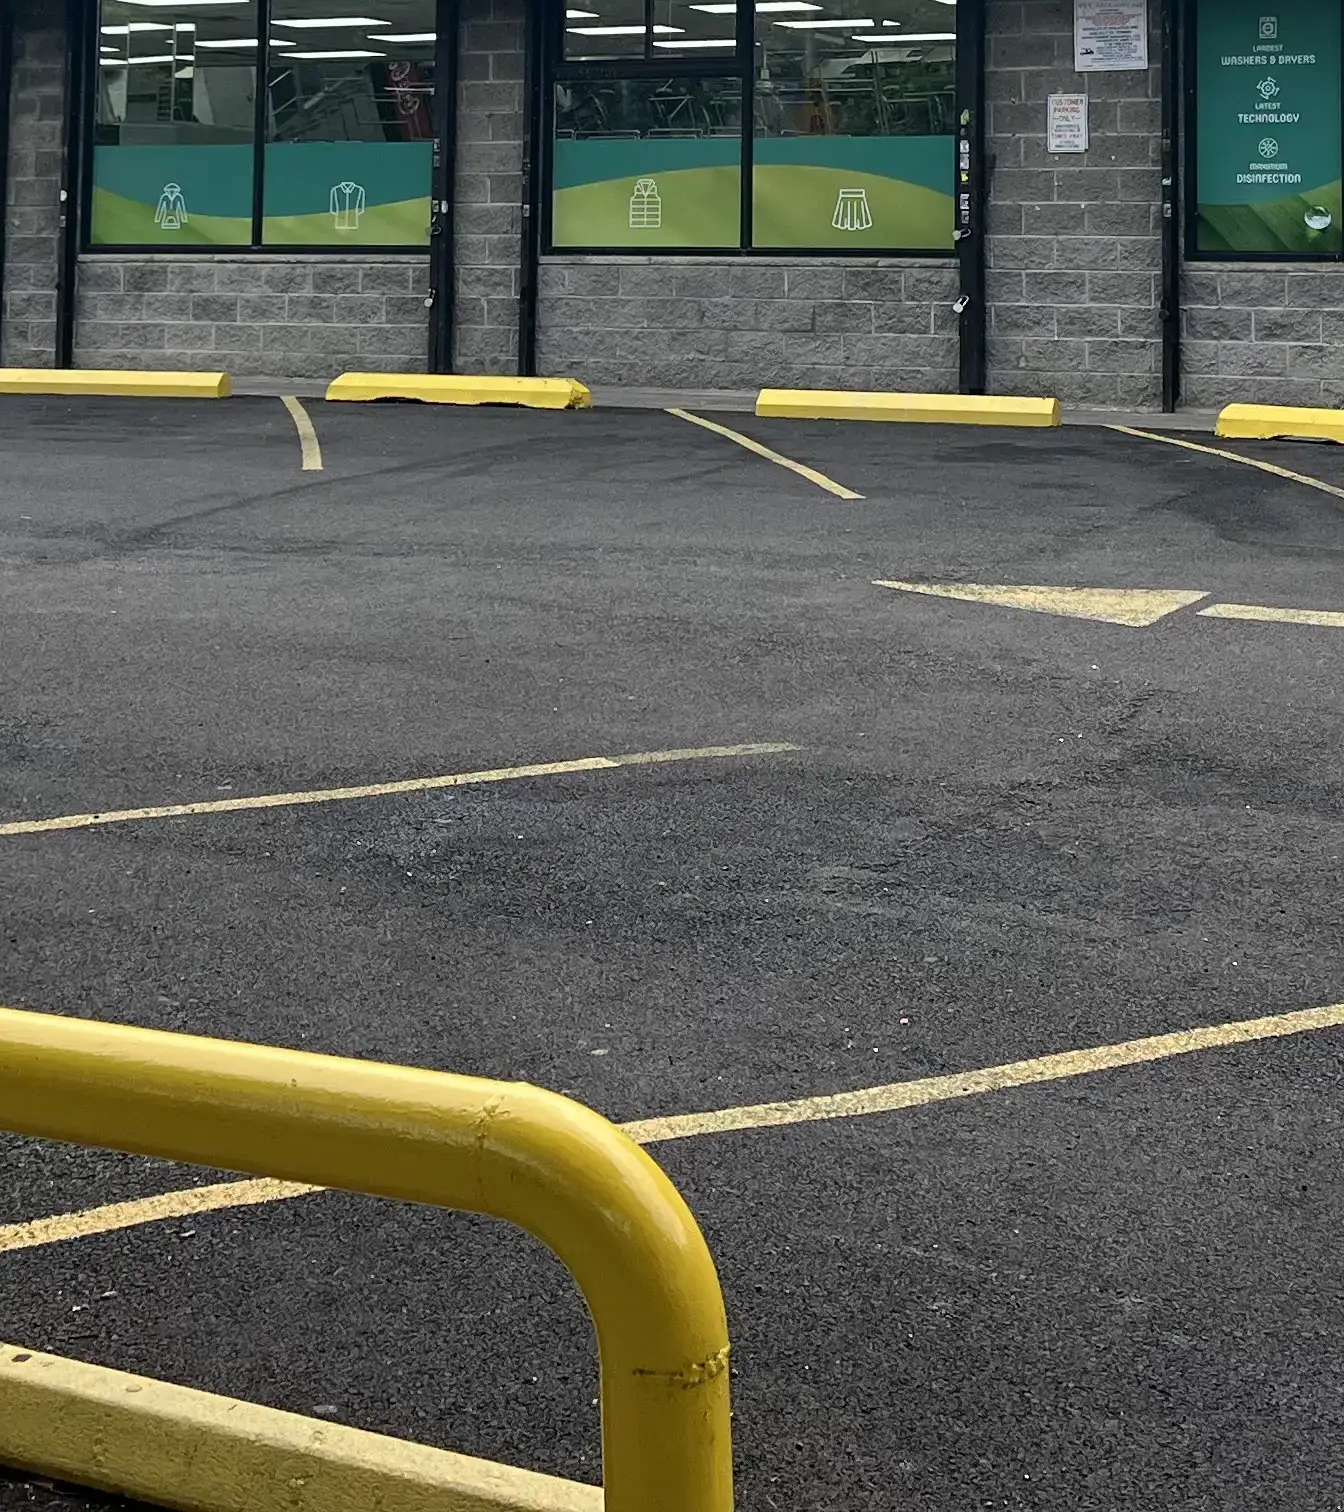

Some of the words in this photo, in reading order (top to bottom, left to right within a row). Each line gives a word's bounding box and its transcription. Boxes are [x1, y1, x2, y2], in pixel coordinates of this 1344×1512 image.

[1220, 55, 1268, 66] WASHERS
[1278, 54, 1316, 65] DRYERS
[1254, 102, 1281, 110] LATEST
[1237, 113, 1300, 124] TECHNOLOGY
[1236, 173, 1302, 184] DISINFECTION
